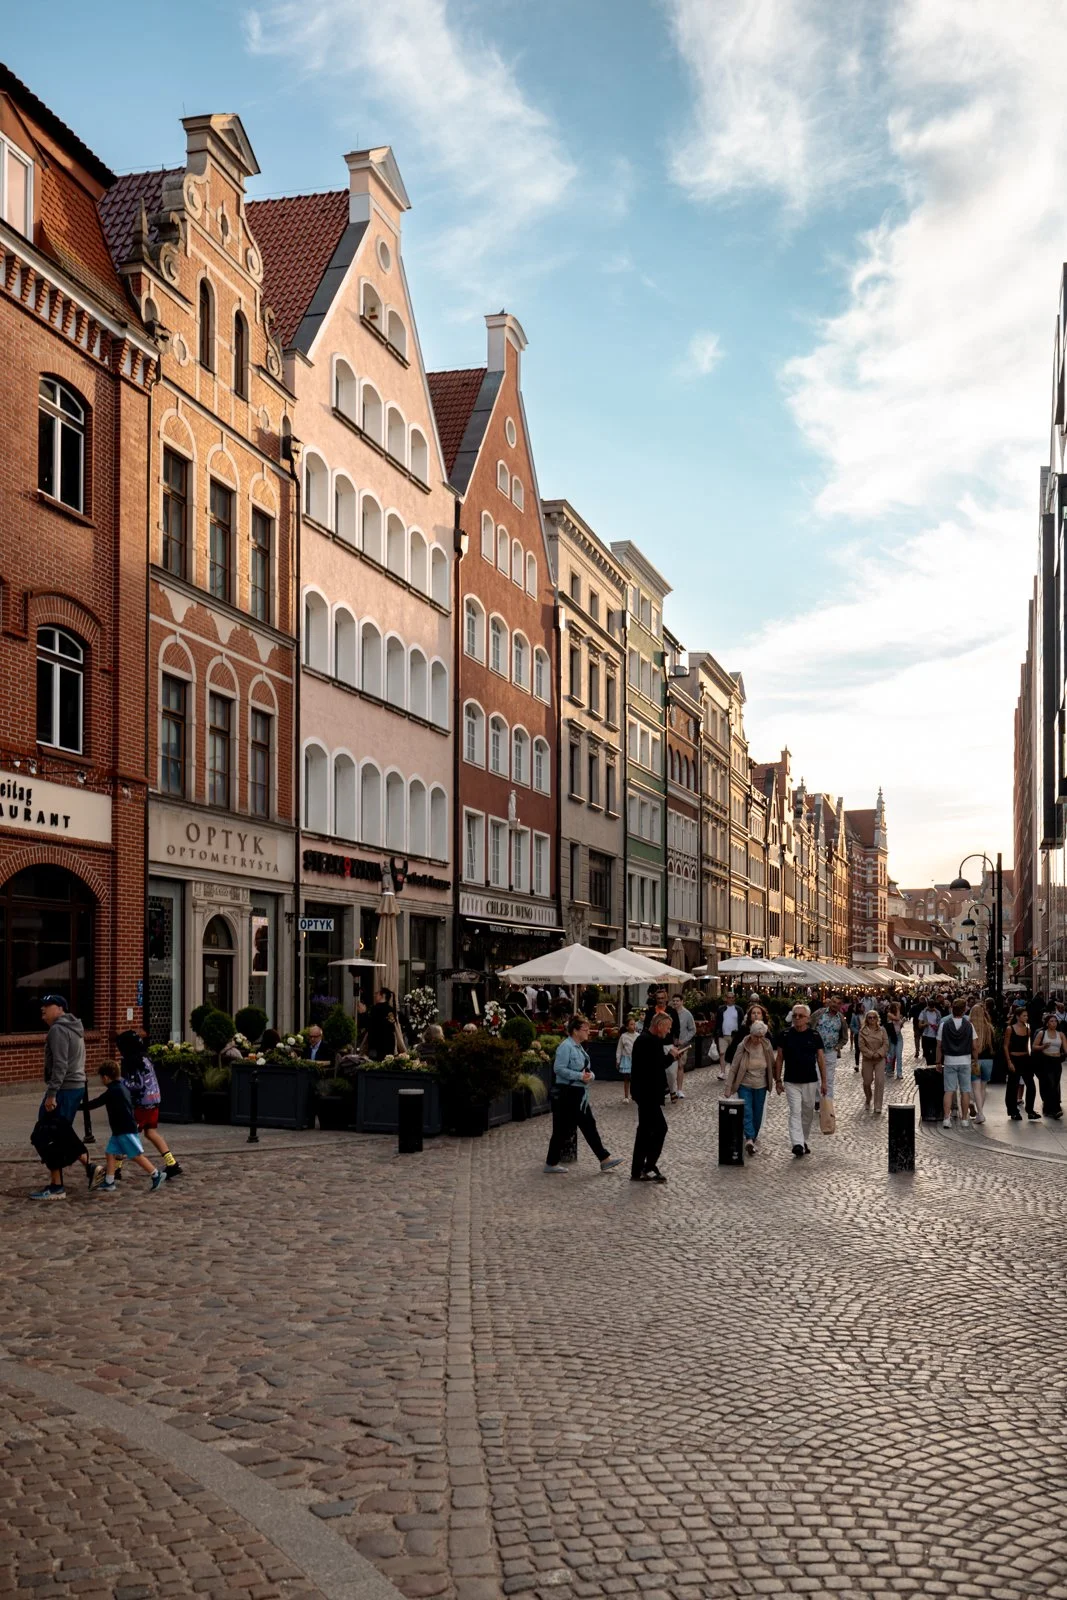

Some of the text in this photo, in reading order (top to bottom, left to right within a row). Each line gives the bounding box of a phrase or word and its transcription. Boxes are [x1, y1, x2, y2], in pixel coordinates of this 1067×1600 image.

[186, 822, 264, 856] OPTYK
[166, 845, 279, 873] OPTOMETRYSTA
[486, 900, 509, 916] CHLEB
[515, 904, 533, 920] WINO
[300, 919, 332, 930] OPTYK
